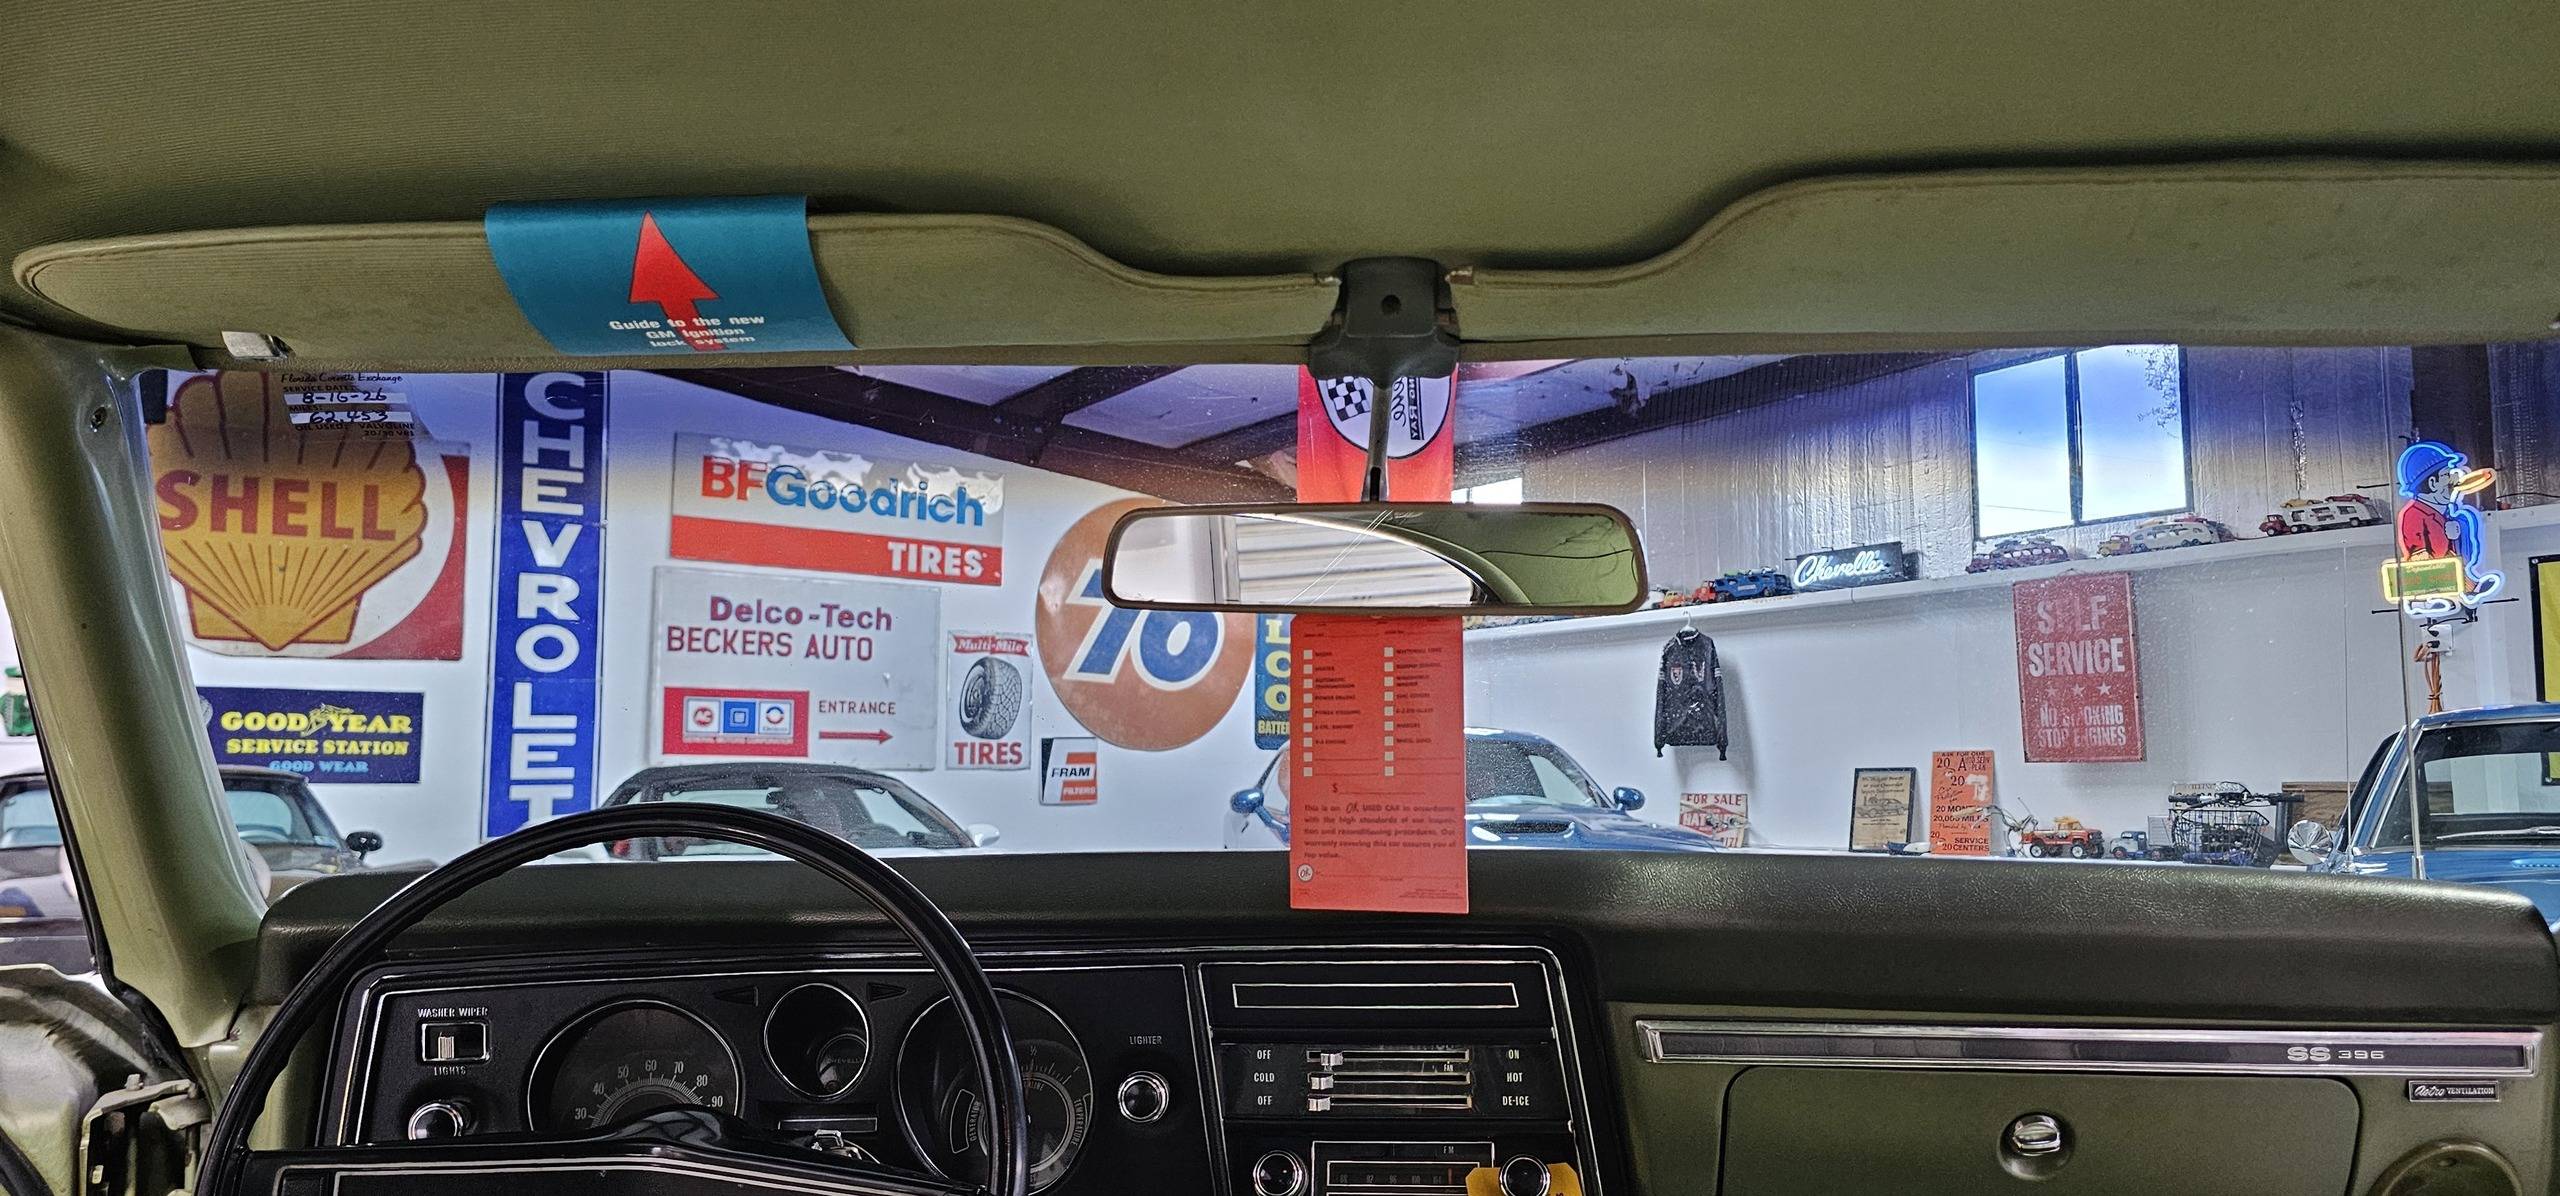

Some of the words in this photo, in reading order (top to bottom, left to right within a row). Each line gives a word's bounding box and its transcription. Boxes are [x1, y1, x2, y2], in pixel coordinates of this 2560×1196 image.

[609, 320, 661, 330] Guide
[667, 318, 686, 328] to
[692, 316, 722, 326] the
[728, 315, 765, 325] new
[646, 330, 676, 339] GM
[649, 339, 687, 348] lock
[695, 335, 756, 346] system
[357, 372, 403, 382] Exchange
[359, 422, 415, 430] VALVOLINE
[702, 455, 983, 526] BFGoodrich
[156, 469, 396, 541] SHELL
[888, 541, 984, 578] TIRES
[509, 372, 585, 828] CHEVROLET
[710, 596, 892, 631] Delco-Tech
[2036, 594, 2109, 635] SLF
[667, 626, 793, 657] BECKERS
[804, 634, 873, 661] AUTO
[958, 639, 1023, 653] Multi-Mile
[2027, 637, 2125, 678] SERVICE
[818, 700, 896, 715] ENTRANCE
[2061, 704, 2124, 729] SOKING
[226, 738, 318, 754] SERVICE
[323, 740, 410, 756] STATION
[954, 742, 1023, 765] TIRES
[269, 760, 315, 773] GOOD
[319, 760, 369, 773] WEAR
[1936, 758, 1950, 768] 20
[1051, 767, 1090, 777] FRAM
[1951, 776, 1965, 786] 20
[1687, 794, 1708, 804] FOR
[1714, 794, 1742, 806] SALE
[418, 1008, 455, 1018] WASHER
[459, 1007, 488, 1017] WIPER
[1129, 1035, 1162, 1046] LIGHTER
[1256, 1049, 1272, 1060] OFF
[1508, 1049, 1520, 1060] ON
[2287, 1047, 2331, 1061] SS
[2337, 1050, 2385, 1059] 396
[434, 1066, 466, 1076] LIGHTS
[618, 1065, 629, 1078] 50
[645, 1060, 657, 1071] 60
[674, 1061, 684, 1073] 70
[1443, 1064, 1454, 1072] FAN
[697, 1075, 708, 1087] 80
[1254, 1072, 1275, 1083] COLD
[1506, 1072, 1523, 1083] HOT
[592, 1083, 605, 1095] 40
[2414, 1085, 2445, 1097] Astro
[2446, 1087, 2495, 1095] VENTILATION
[712, 1096, 723, 1107] 90
[1257, 1095, 1272, 1106] OFF
[1502, 1096, 1530, 1106] DE-ICE
[575, 1108, 587, 1120] 30
[1072, 1099, 1087, 1146] TEMPERATURE
